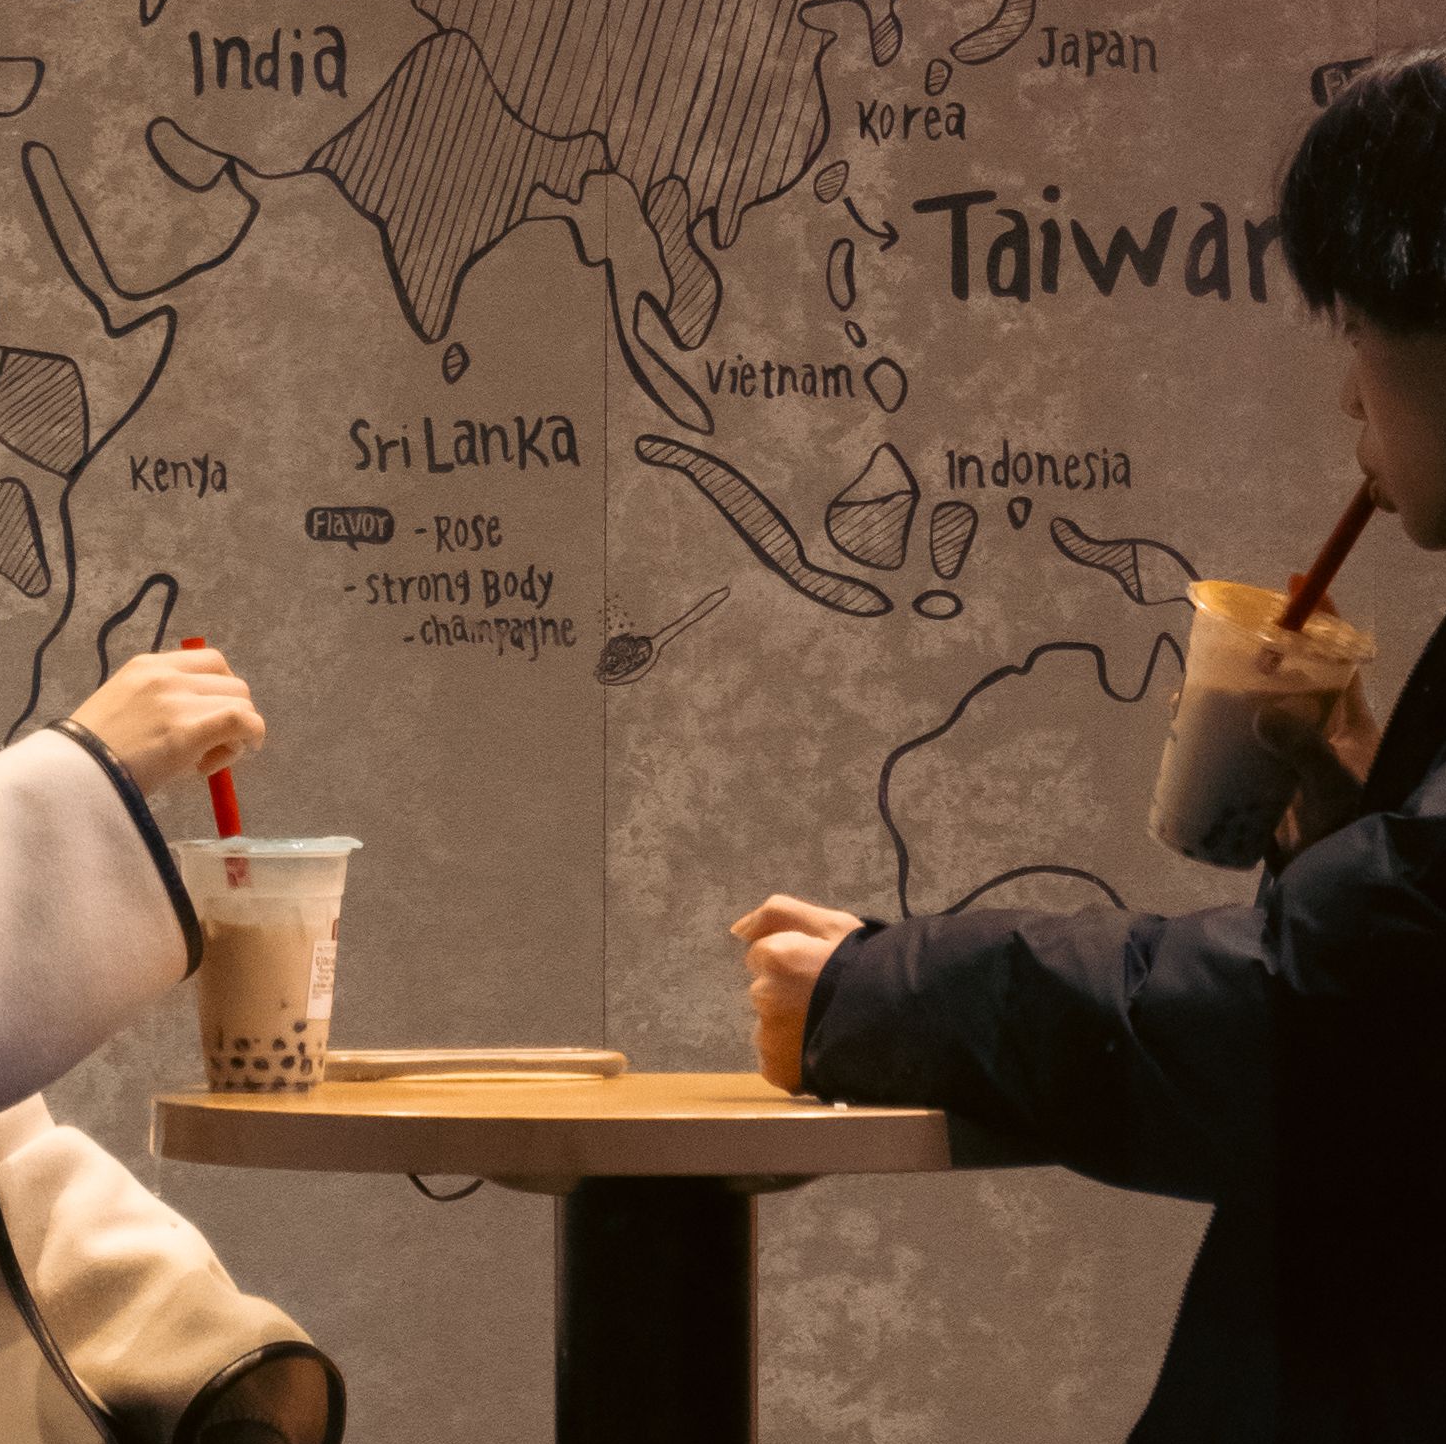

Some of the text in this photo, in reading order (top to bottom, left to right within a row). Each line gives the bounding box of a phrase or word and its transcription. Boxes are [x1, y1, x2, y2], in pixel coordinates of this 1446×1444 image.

[188, 24, 347, 97] India
[1038, 26, 1158, 78] Japan
[856, 100, 966, 146] Korea
[705, 354, 856, 399] Vietnam
[350, 414, 580, 473] Sri Lanka
[947, 439, 1132, 490] Indonesia
[130, 453, 228, 499] Kenya
[310, 511, 391, 539] Flavor
[482, 564, 554, 609] Body
